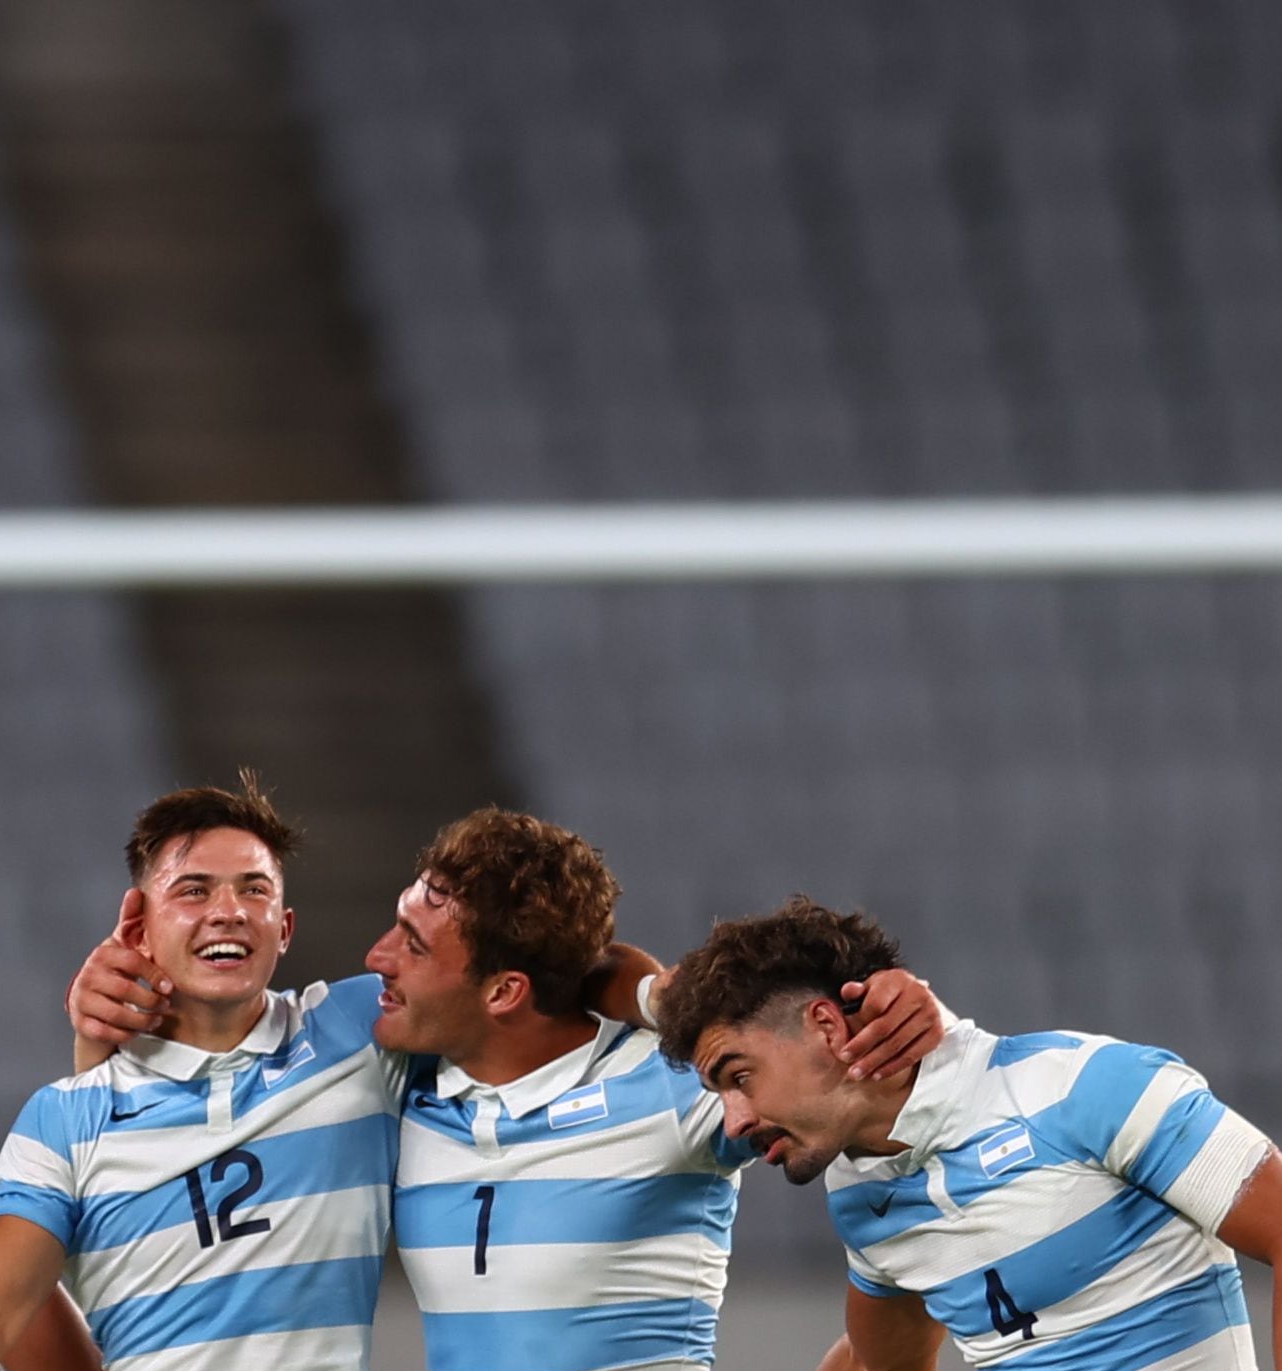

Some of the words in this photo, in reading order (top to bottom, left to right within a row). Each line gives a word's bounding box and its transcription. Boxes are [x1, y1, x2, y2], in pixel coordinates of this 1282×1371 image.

[184, 1148, 271, 1249] 12
[472, 1185, 495, 1275] 1
[983, 1267, 1039, 1340] 4
